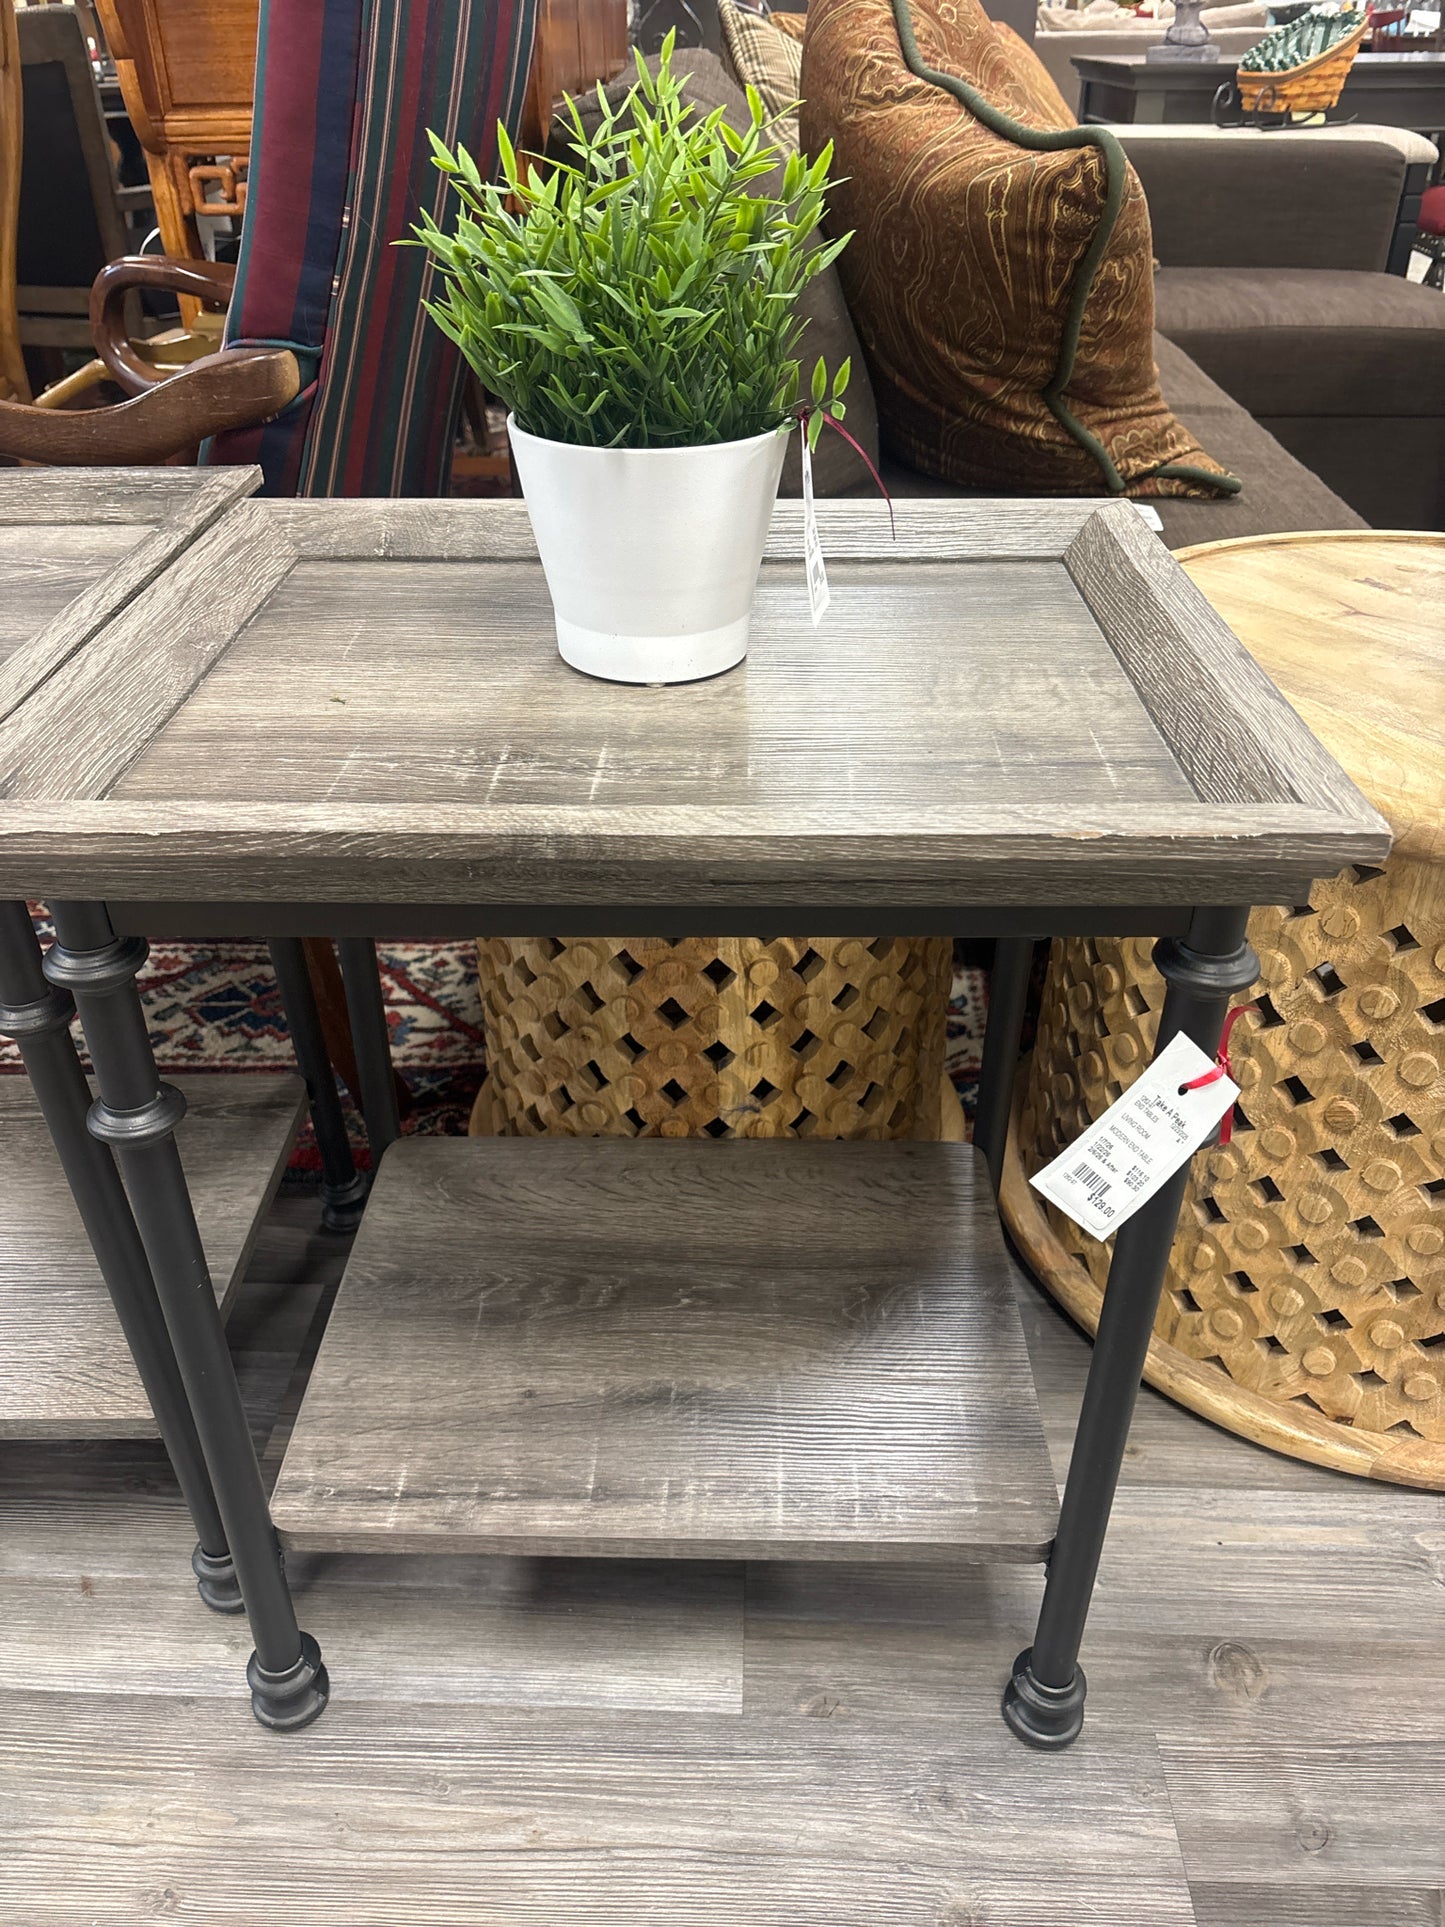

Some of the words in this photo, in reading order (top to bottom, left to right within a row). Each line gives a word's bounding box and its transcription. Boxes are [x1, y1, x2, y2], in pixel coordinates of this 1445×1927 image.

[1134, 1100, 1145, 1110] END
[1143, 1107, 1159, 1123] TABLES
[1152, 1095, 1168, 1112] Take
[1165, 1109, 1174, 1117] A
[1171, 1112, 1186, 1129] Peak
[1121, 1112, 1138, 1128] LIVING
[1135, 1124, 1151, 1140] ROOM
[1099, 1136, 1114, 1150] 1/7/26
[1109, 1124, 1130, 1144] MODERN
[1127, 1141, 1140, 1152] END
[1137, 1149, 1153, 1165] TABLE
[1087, 1192, 1115, 1218] $129.00
